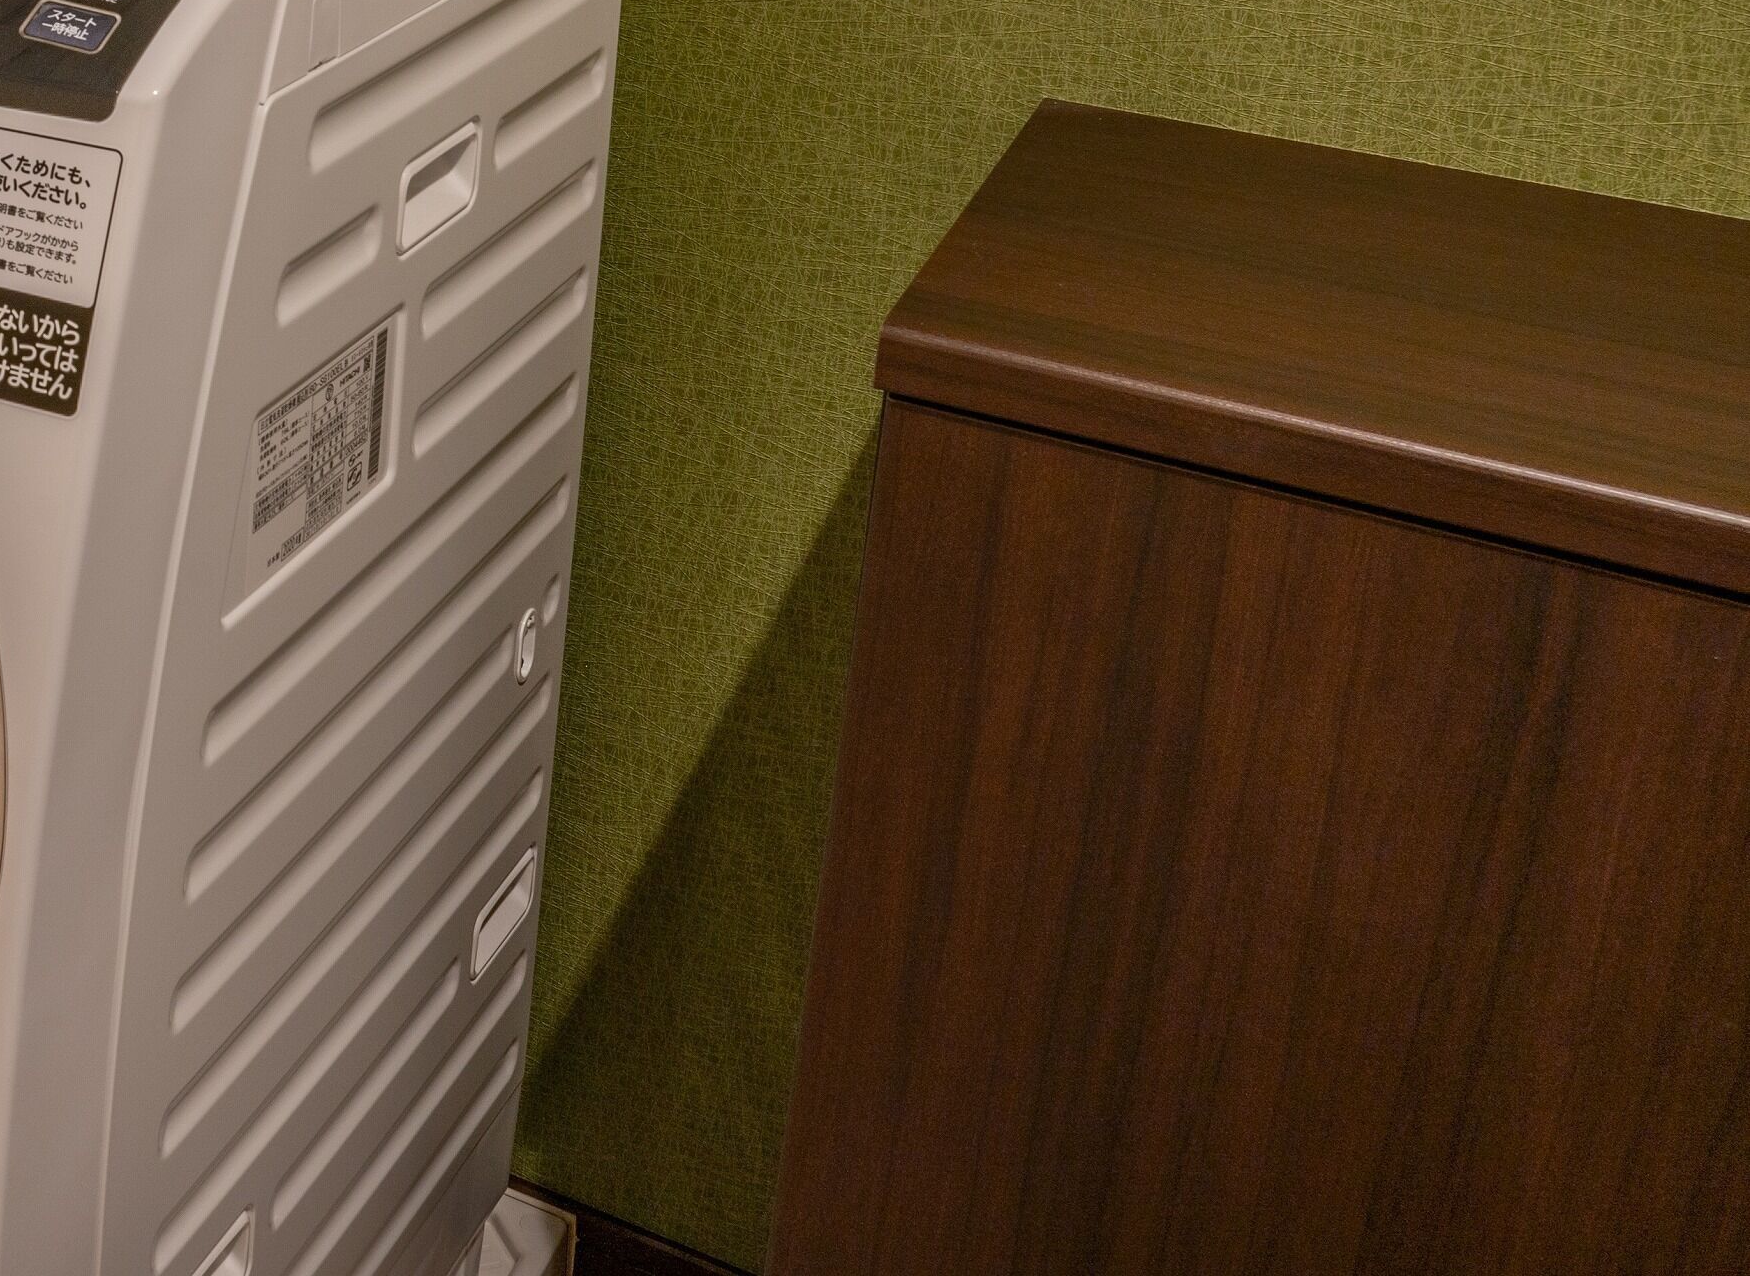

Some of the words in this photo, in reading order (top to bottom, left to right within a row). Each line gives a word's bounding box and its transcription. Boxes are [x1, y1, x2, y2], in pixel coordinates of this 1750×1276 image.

[47, 9, 97, 27] スタート
[41, 22, 89, 41] 一時停止
